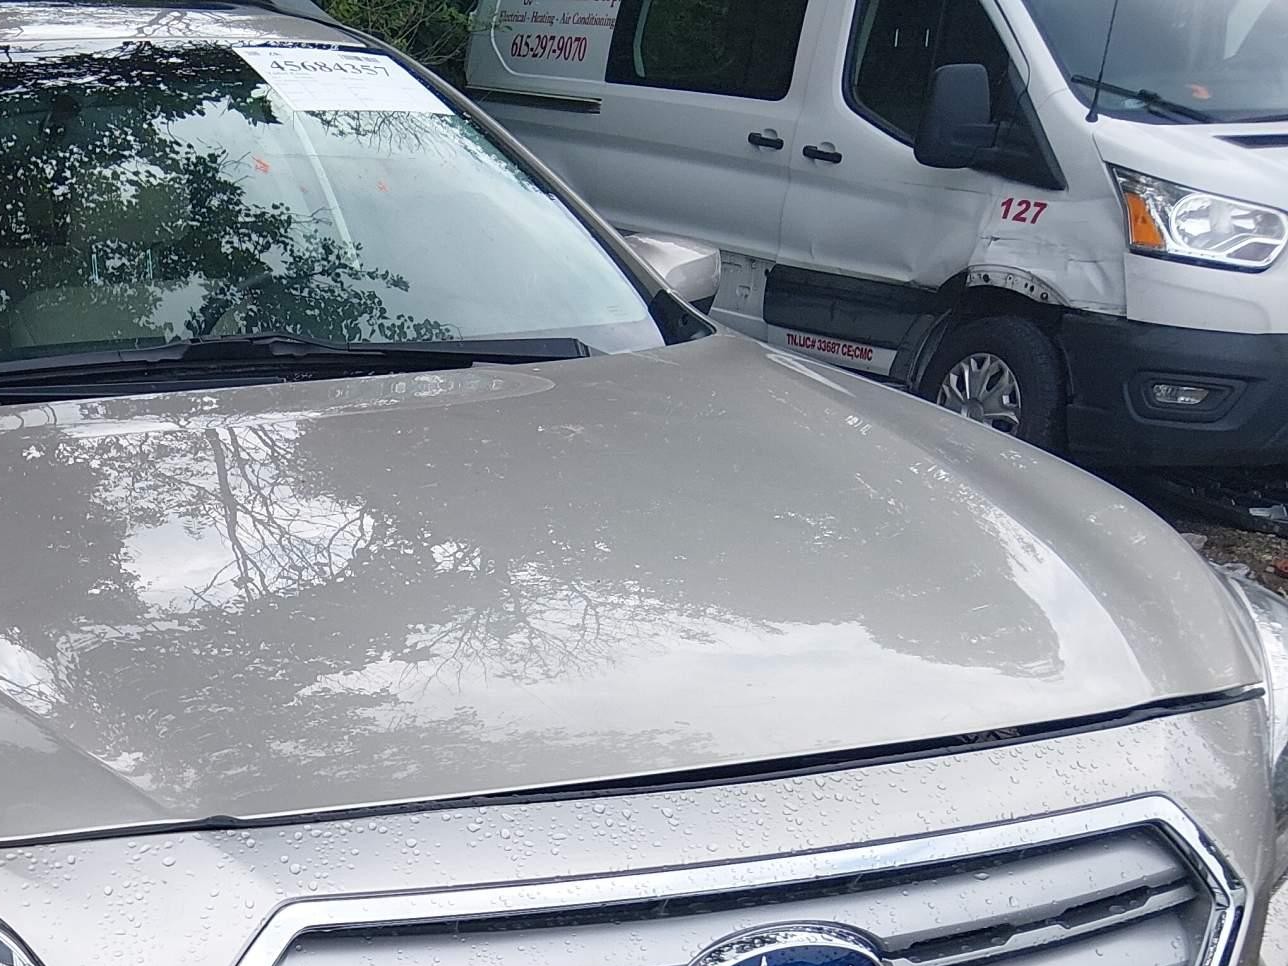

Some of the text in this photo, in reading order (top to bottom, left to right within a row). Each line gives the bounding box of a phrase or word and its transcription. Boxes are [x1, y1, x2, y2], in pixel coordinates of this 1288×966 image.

[532, 11, 555, 26] Heating
[560, 12, 572, 25] Air
[573, 12, 616, 29] Conditioning
[511, 33, 588, 62] 615-297-9070
[270, 59, 391, 78] 45684357
[1001, 197, 1048, 225] 127
[817, 339, 841, 355] 33687
